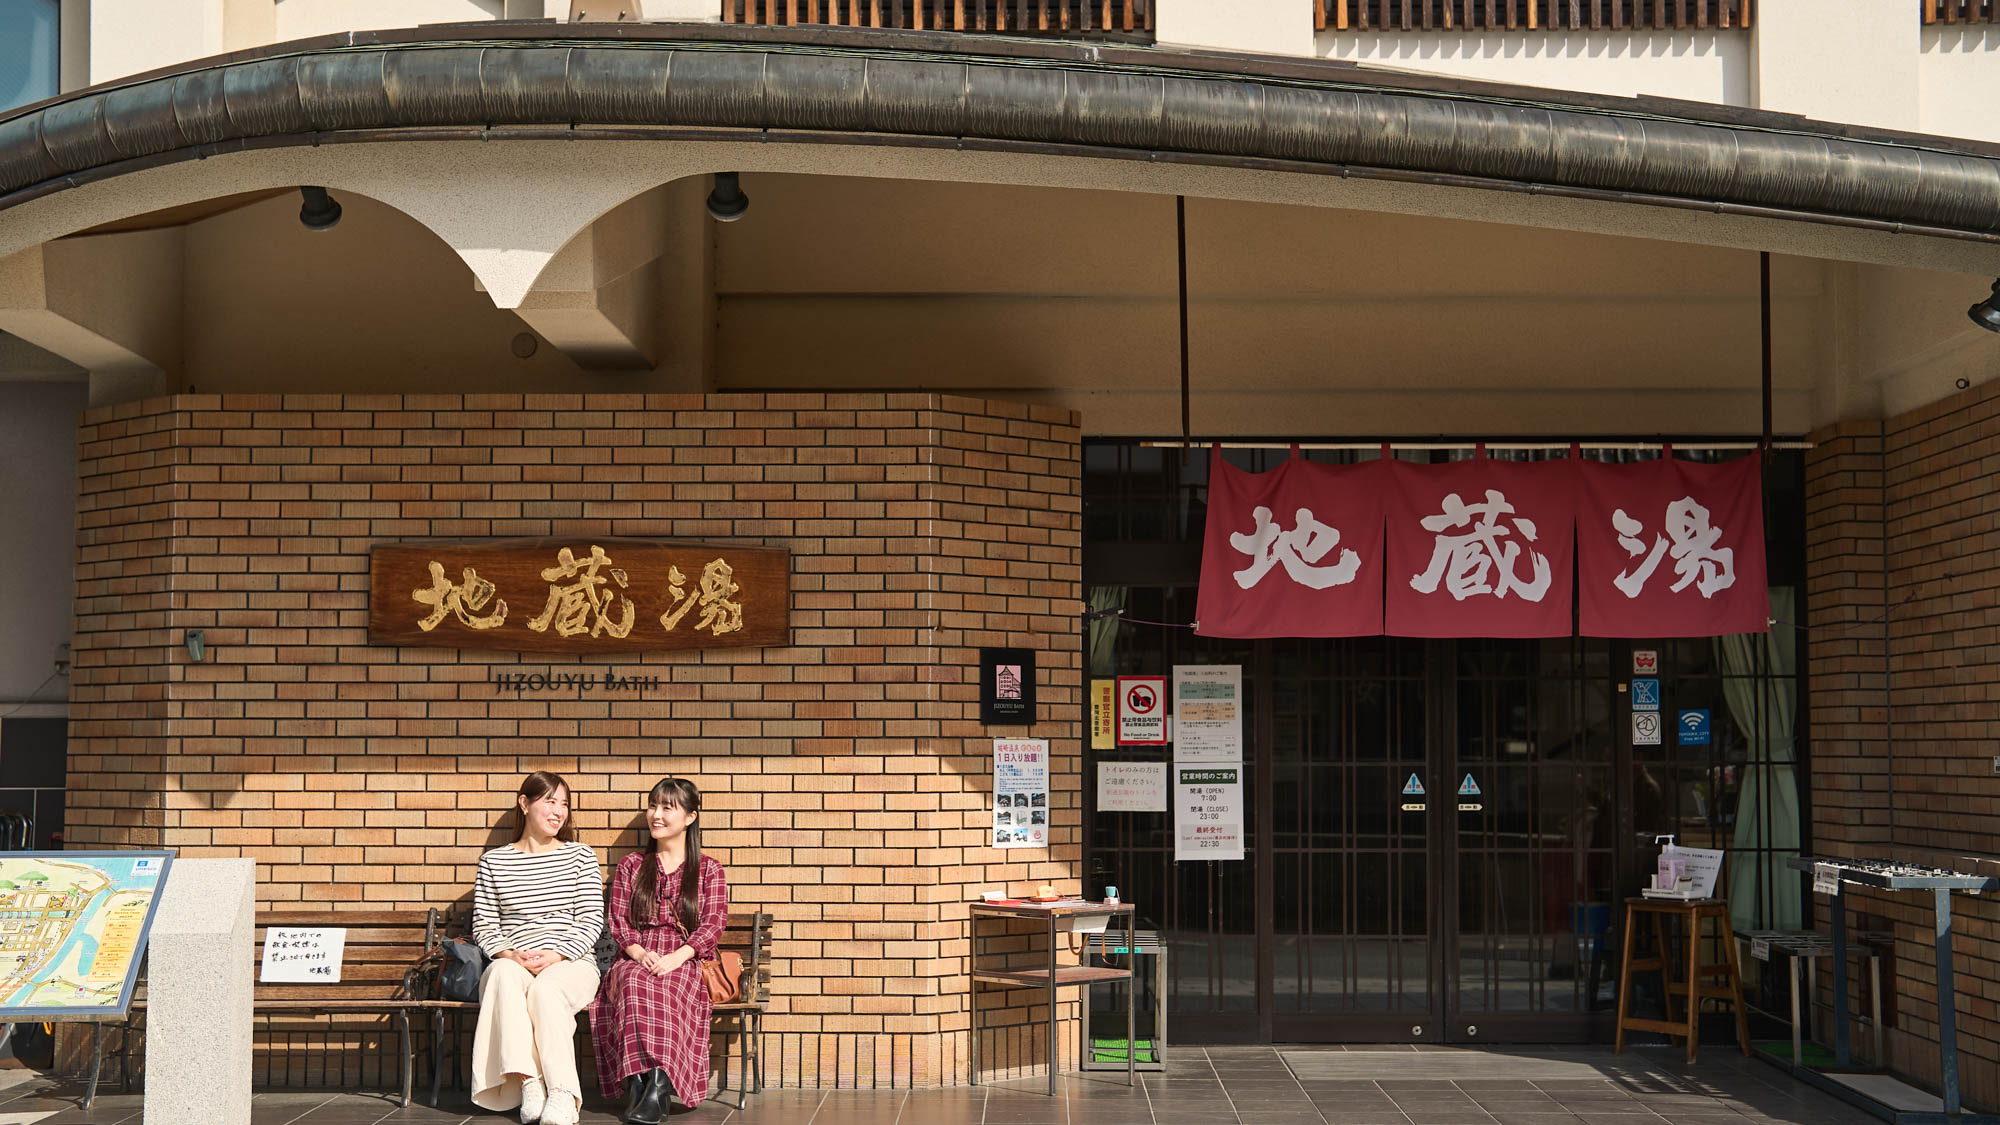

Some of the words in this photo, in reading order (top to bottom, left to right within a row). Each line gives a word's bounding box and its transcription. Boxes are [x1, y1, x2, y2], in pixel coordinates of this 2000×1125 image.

[1230, 490, 1736, 602] 地蔵湯
[412, 545, 743, 638] 地蔵湯
[496, 673, 595, 695] JIZOUYU
[604, 673, 659, 691] BATH
[1181, 772, 1236, 780] 営業時間のご案内
